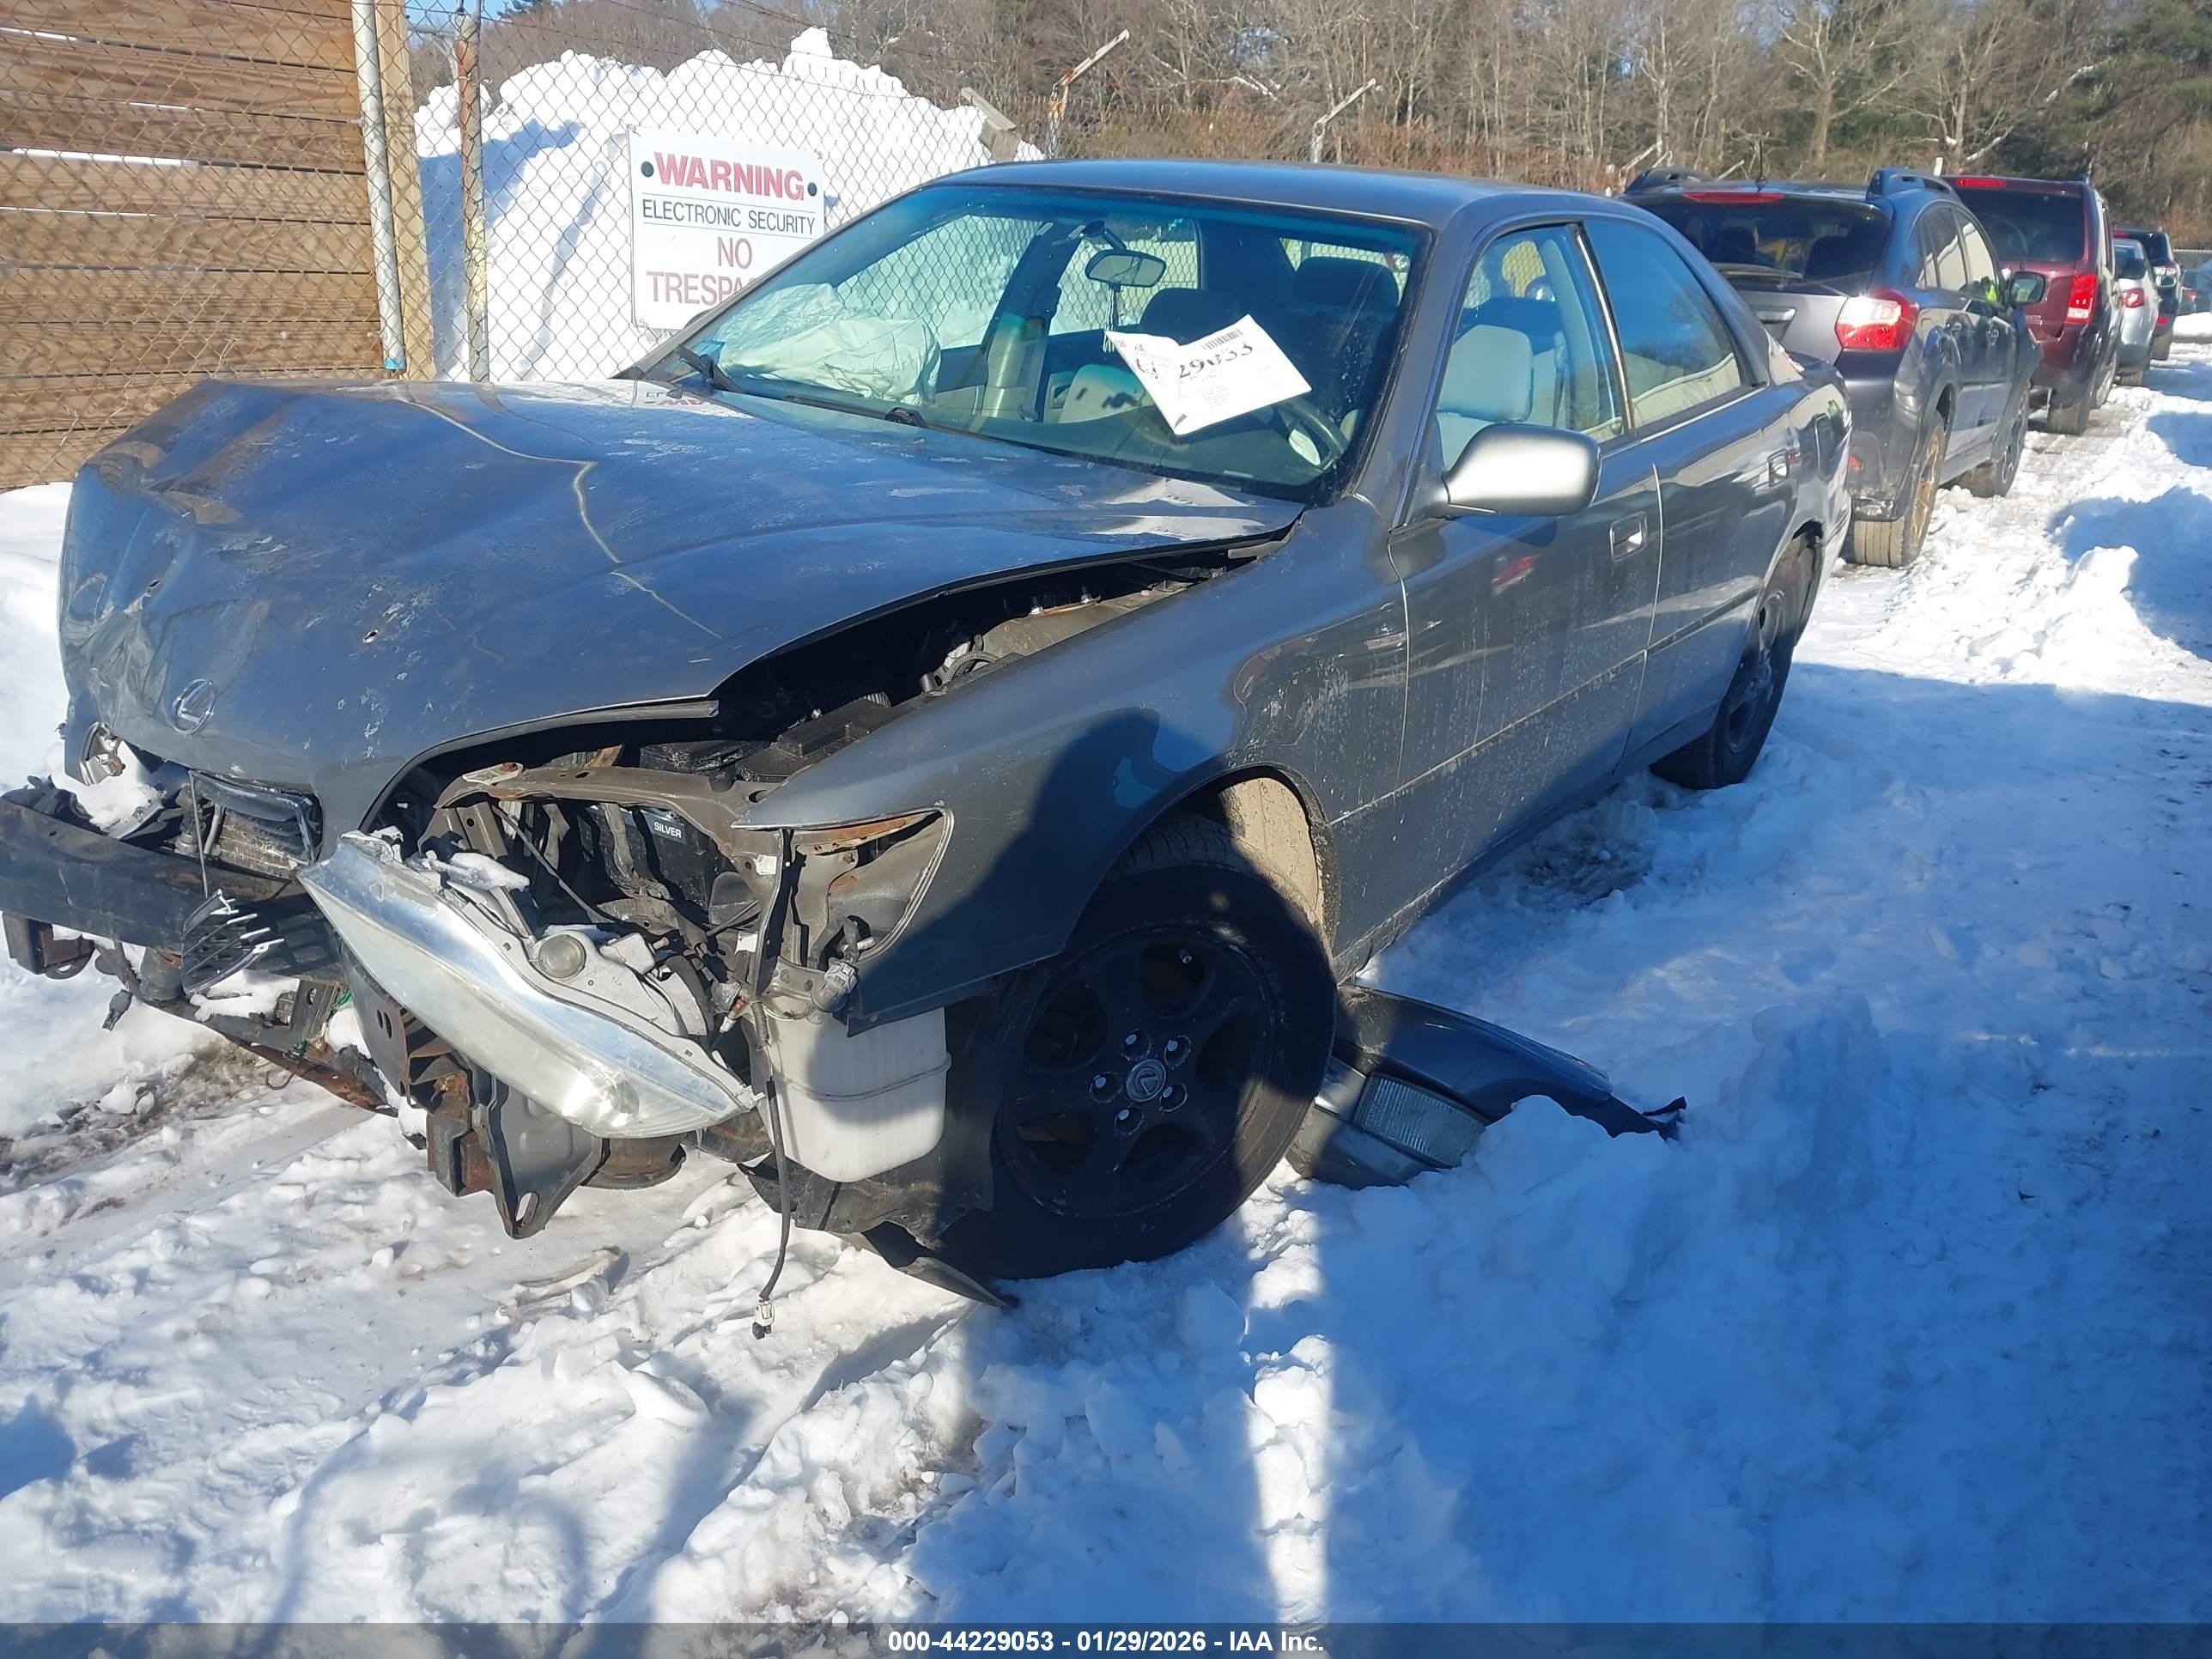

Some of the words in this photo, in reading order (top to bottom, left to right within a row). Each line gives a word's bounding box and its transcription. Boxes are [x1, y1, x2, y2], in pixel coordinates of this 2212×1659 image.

[654, 152, 805, 201] WARNING
[642, 198, 742, 228] ELECTRONIC
[748, 210, 815, 235] SECURITY
[717, 236, 752, 270] NO
[646, 270, 756, 306] TRESPA
[653, 821, 682, 838] SILVER
